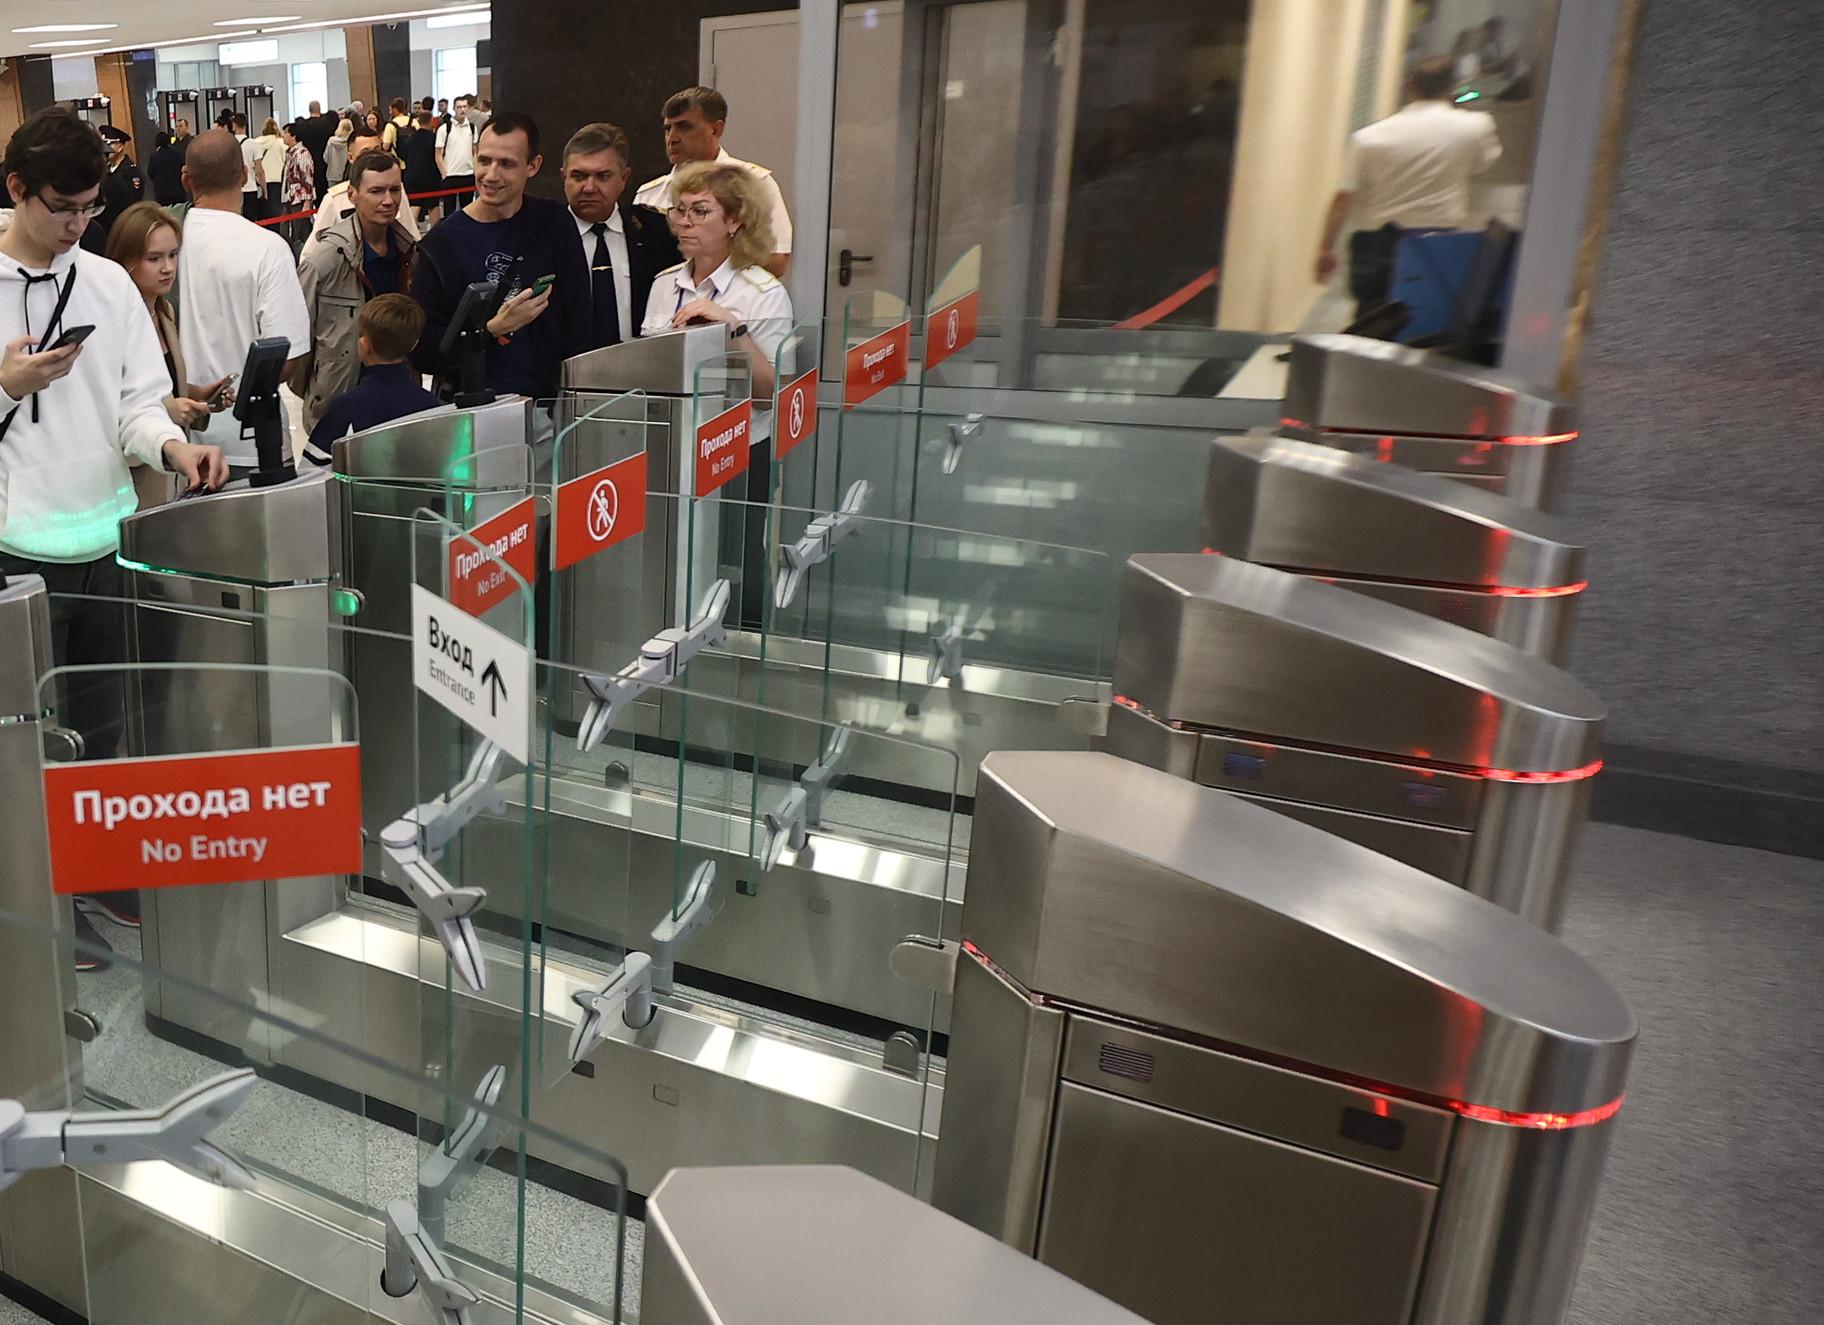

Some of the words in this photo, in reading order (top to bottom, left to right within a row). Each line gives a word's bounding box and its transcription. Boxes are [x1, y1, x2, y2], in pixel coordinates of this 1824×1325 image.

[701, 427, 733, 460] Прохода
[733, 420, 747, 439] нет
[711, 463, 720, 476] No
[720, 454, 735, 471] Entry
[509, 523, 529, 548] нет
[478, 579, 490, 597] No
[490, 568, 506, 589] Exit
[429, 615, 474, 678] Вход
[429, 658, 475, 705] Entrance
[72, 786, 251, 831] Прохода
[262, 780, 332, 811] нет
[141, 838, 183, 864] No
[190, 834, 268, 863] Entry
